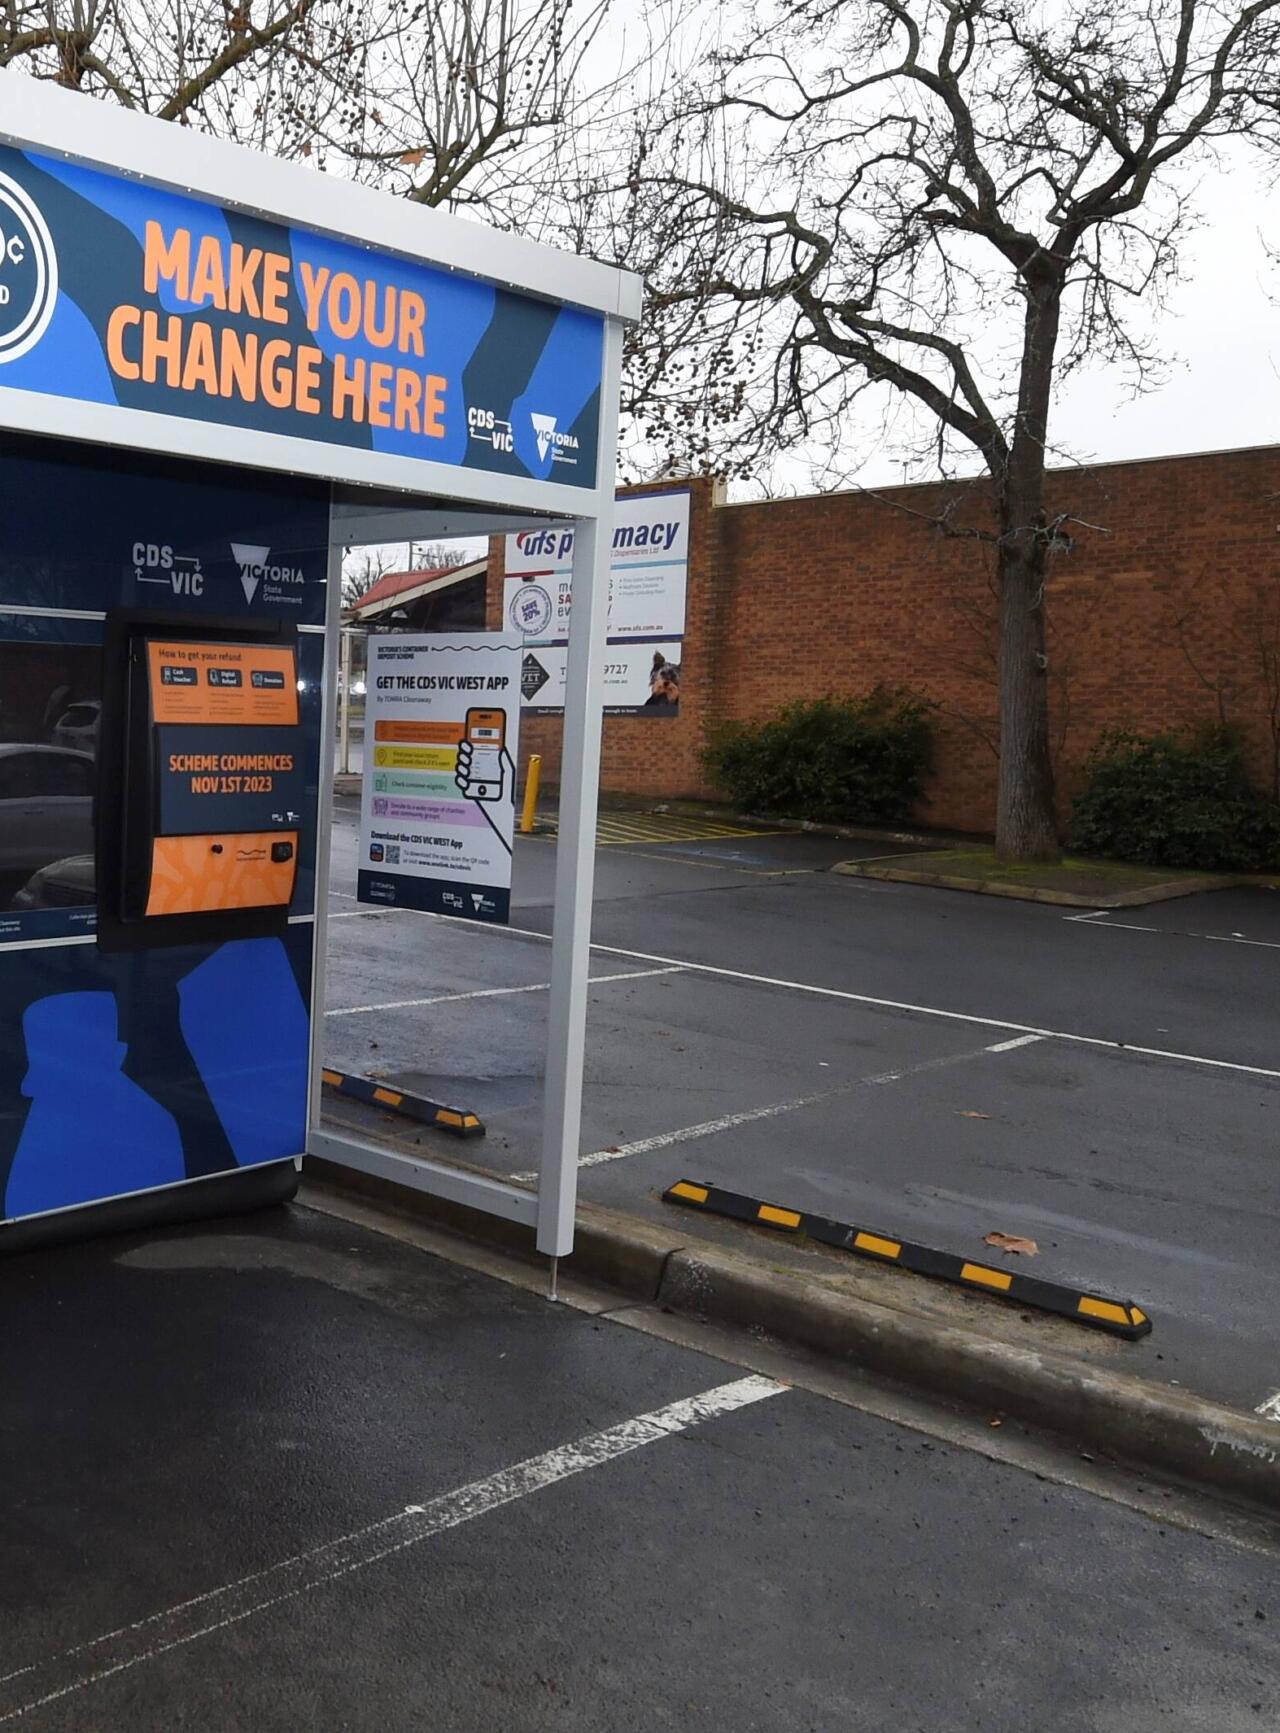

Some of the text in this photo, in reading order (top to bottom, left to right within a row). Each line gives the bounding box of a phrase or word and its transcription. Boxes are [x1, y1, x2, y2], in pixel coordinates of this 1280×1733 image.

[144, 219, 426, 358] MAKE YOUR
[106, 304, 447, 438] CHANGE HERE
[468, 407, 495, 429] CDS
[491, 431, 514, 453] VIC
[536, 429, 579, 449] VICTORIA
[524, 530, 556, 556] ufs
[133, 542, 174, 569] CDS
[238, 553, 305, 584] VICTORIA
[171, 571, 204, 596] VIC
[263, 593, 302, 604] Government
[523, 608, 540, 622] 20%
[159, 649, 176, 657] How
[188, 651, 199, 661] get
[201, 652, 217, 661] your
[219, 652, 242, 661] refund
[376, 676, 395, 689] GET
[396, 676, 416, 689] THE
[417, 676, 436, 690] CDS
[438, 676, 455, 690] VIC
[456, 676, 486, 690] WEST
[487, 676, 509, 690] APP
[170, 754, 293, 772] SCHEME COMMENCES
[191, 776, 272, 793] NOV 1ST 2023
[371, 831, 463, 849] Download the CDS VIC WEST App
